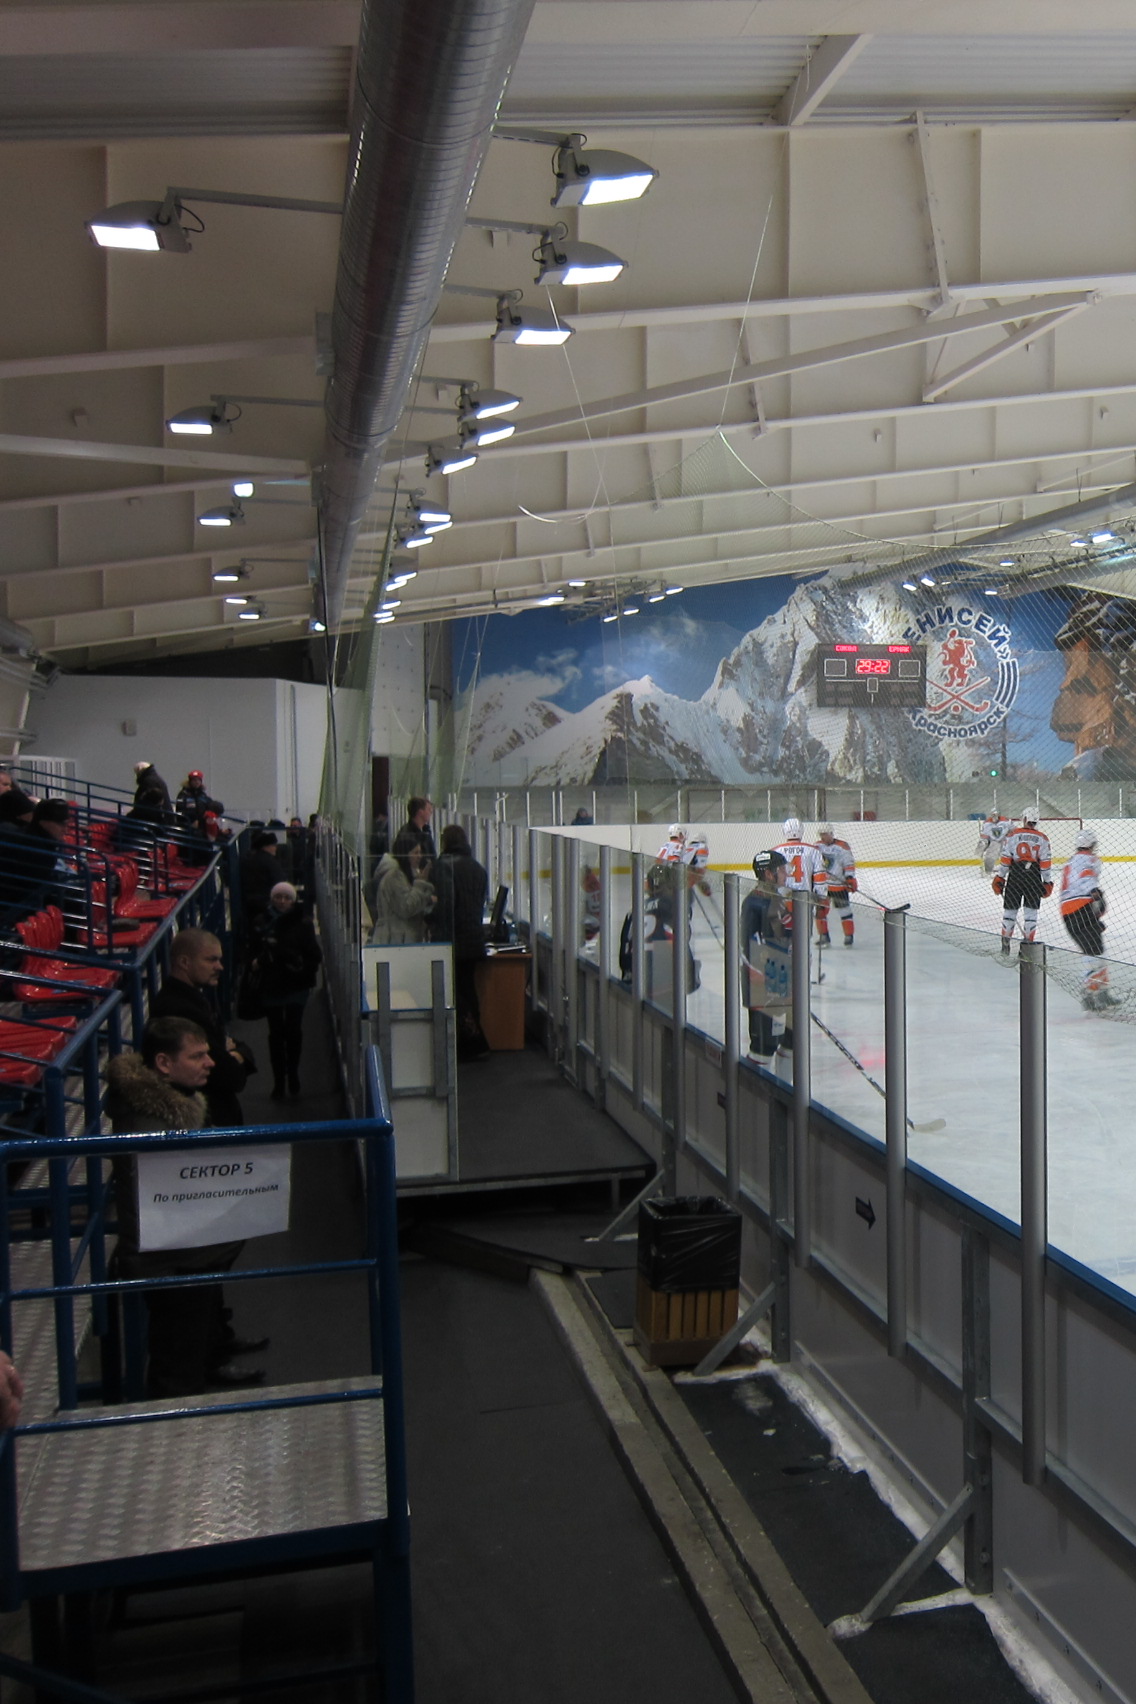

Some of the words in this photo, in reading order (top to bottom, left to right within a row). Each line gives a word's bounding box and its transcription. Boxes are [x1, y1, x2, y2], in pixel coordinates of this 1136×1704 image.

[857, 660, 889, 674] 29:22
[179, 1163, 241, 1180] СЕКТОР
[244, 1162, 254, 1175] 5
[153, 1193, 169, 1203] По
[172, 1183, 279, 1203] пригласительным
